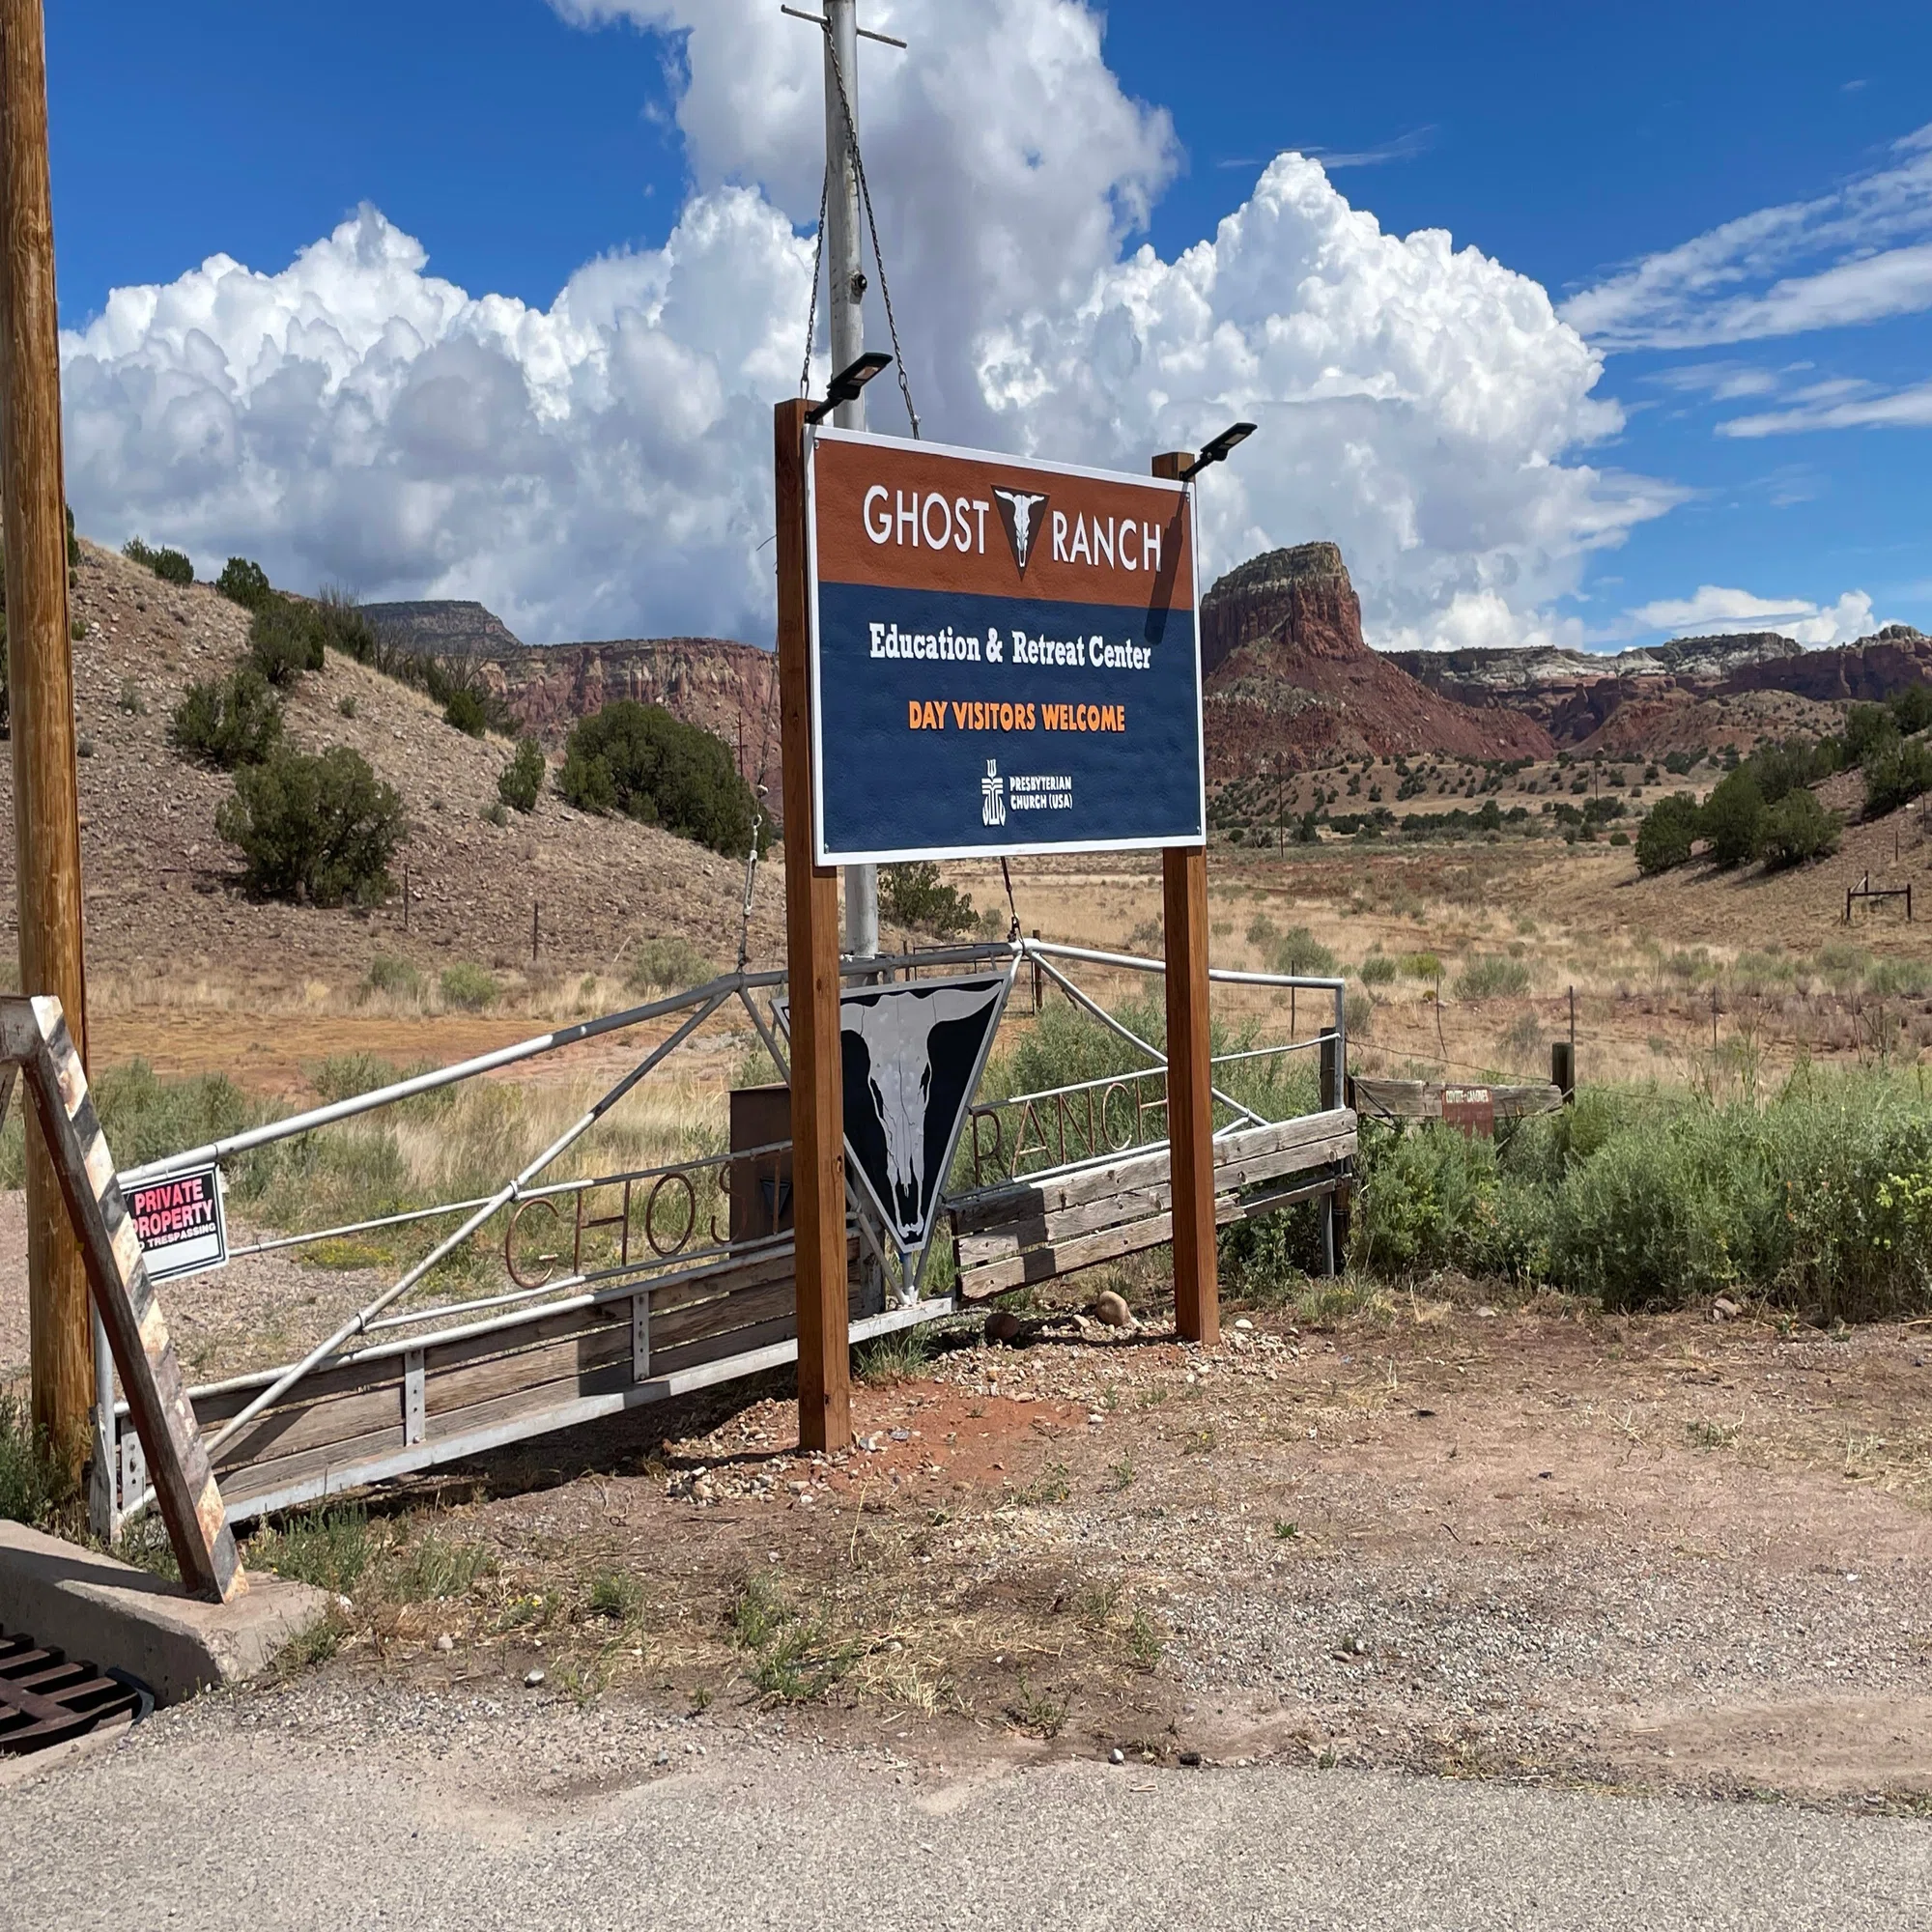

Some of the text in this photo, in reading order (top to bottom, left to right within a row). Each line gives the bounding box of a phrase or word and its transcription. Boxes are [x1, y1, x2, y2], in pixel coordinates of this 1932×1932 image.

[863, 484, 1162, 572] GHOST RANCH
[869, 622, 1151, 669] Education & Retreat Center
[909, 700, 1125, 732] DAY VISITORS WELCOME
[1009, 776, 1072, 791] PRESBYTERIAN
[1010, 793, 1073, 810] CHURCH (USA)
[971, 1069, 1171, 1189] RANCH
[134, 1179, 203, 1215] PRIVATE
[138, 1223, 215, 1250] O TRESPASSING
[505, 1147, 793, 1290] GHOST
